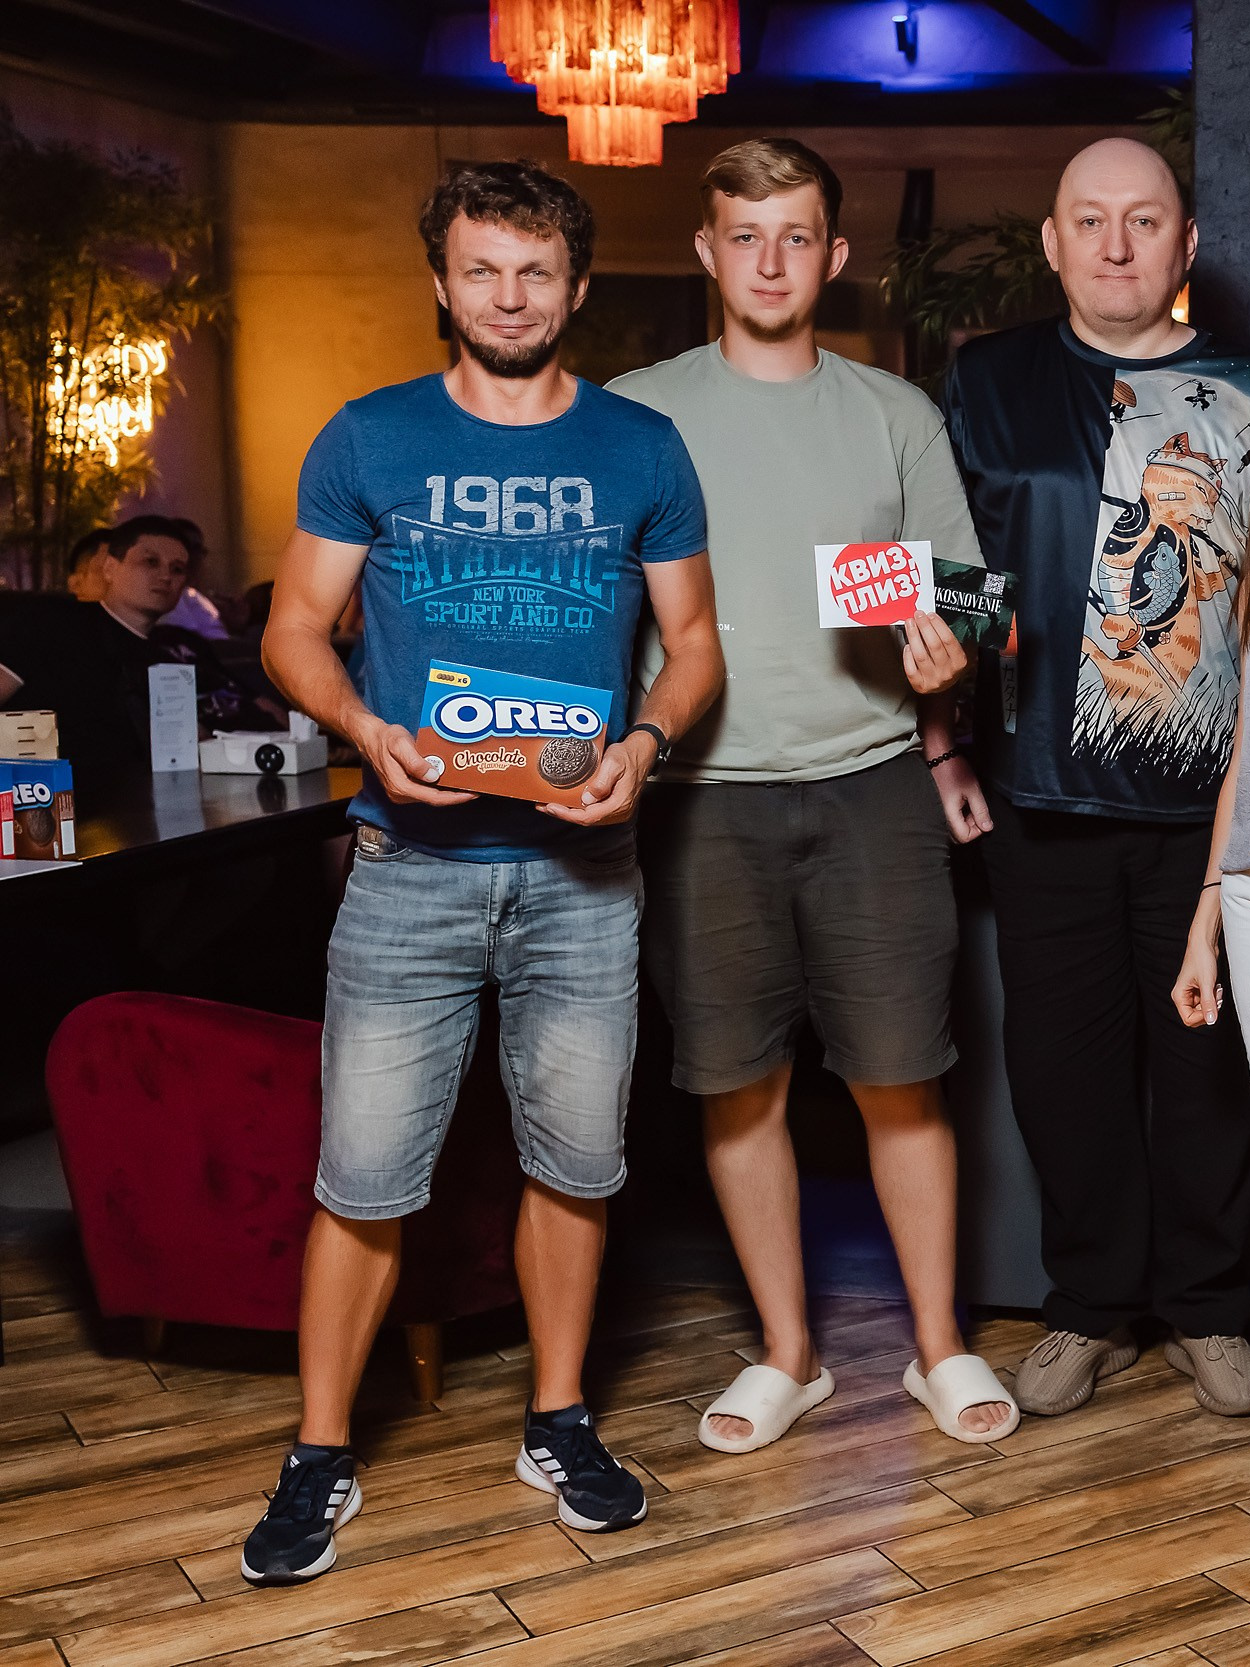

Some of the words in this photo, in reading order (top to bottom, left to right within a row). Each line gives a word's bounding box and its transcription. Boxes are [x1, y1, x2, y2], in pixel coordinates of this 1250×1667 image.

[426, 475, 594, 535] 1968
[409, 529, 608, 599] ATHLETIC
[473, 586, 505, 602] NEW
[508, 585, 546, 604] YORK
[835, 571, 921, 615] ПЛИЗ!
[424, 601, 502, 625] SPORT
[508, 604, 558, 627] AND
[564, 606, 595, 630] CO.
[716, 623, 735, 631] OM.
[440, 696, 599, 734] OREO
[454, 747, 526, 769] Chocolate
